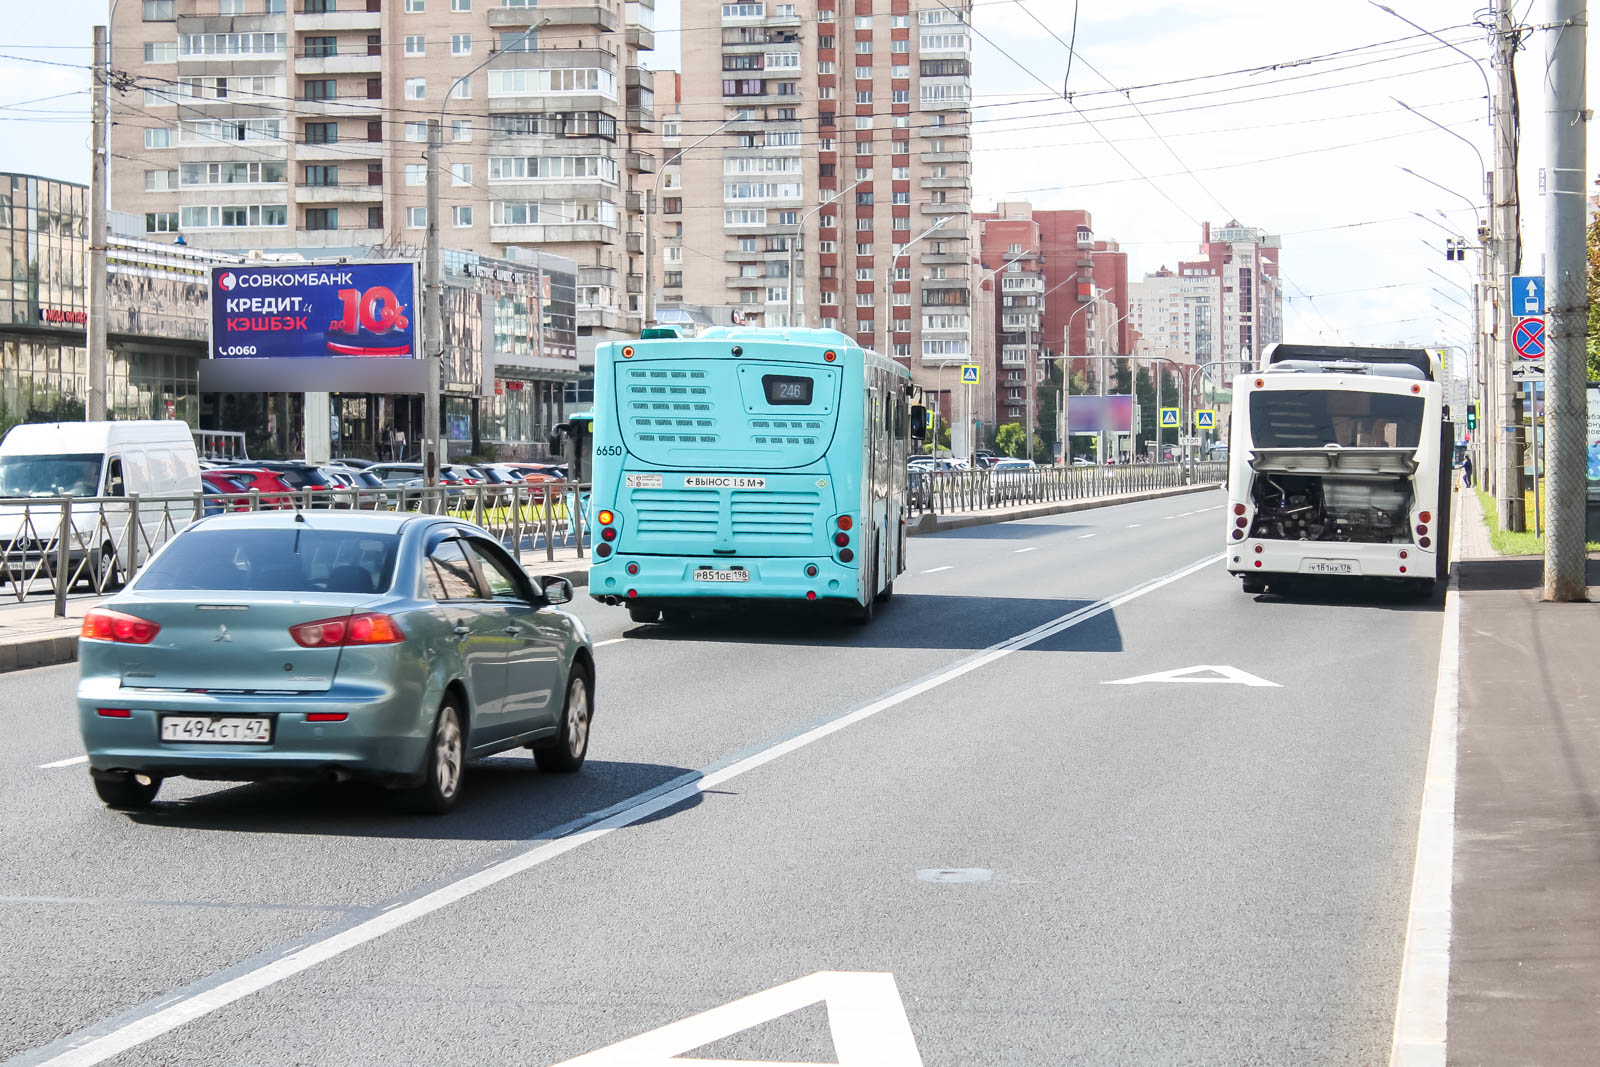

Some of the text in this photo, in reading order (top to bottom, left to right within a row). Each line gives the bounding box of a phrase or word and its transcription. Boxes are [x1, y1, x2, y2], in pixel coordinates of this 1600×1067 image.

[239, 272, 353, 288] СОВКОМБАНК
[226, 297, 303, 314] КРЕДИТ
[227, 316, 309, 331] КЭШБЭК
[228, 346, 257, 356] 0060
[780, 383, 801, 398] 246
[596, 445, 623, 456] 6650
[695, 477, 756, 487] ВЫНОС 1.5 М
[170, 720, 241, 738] Т494СТ
